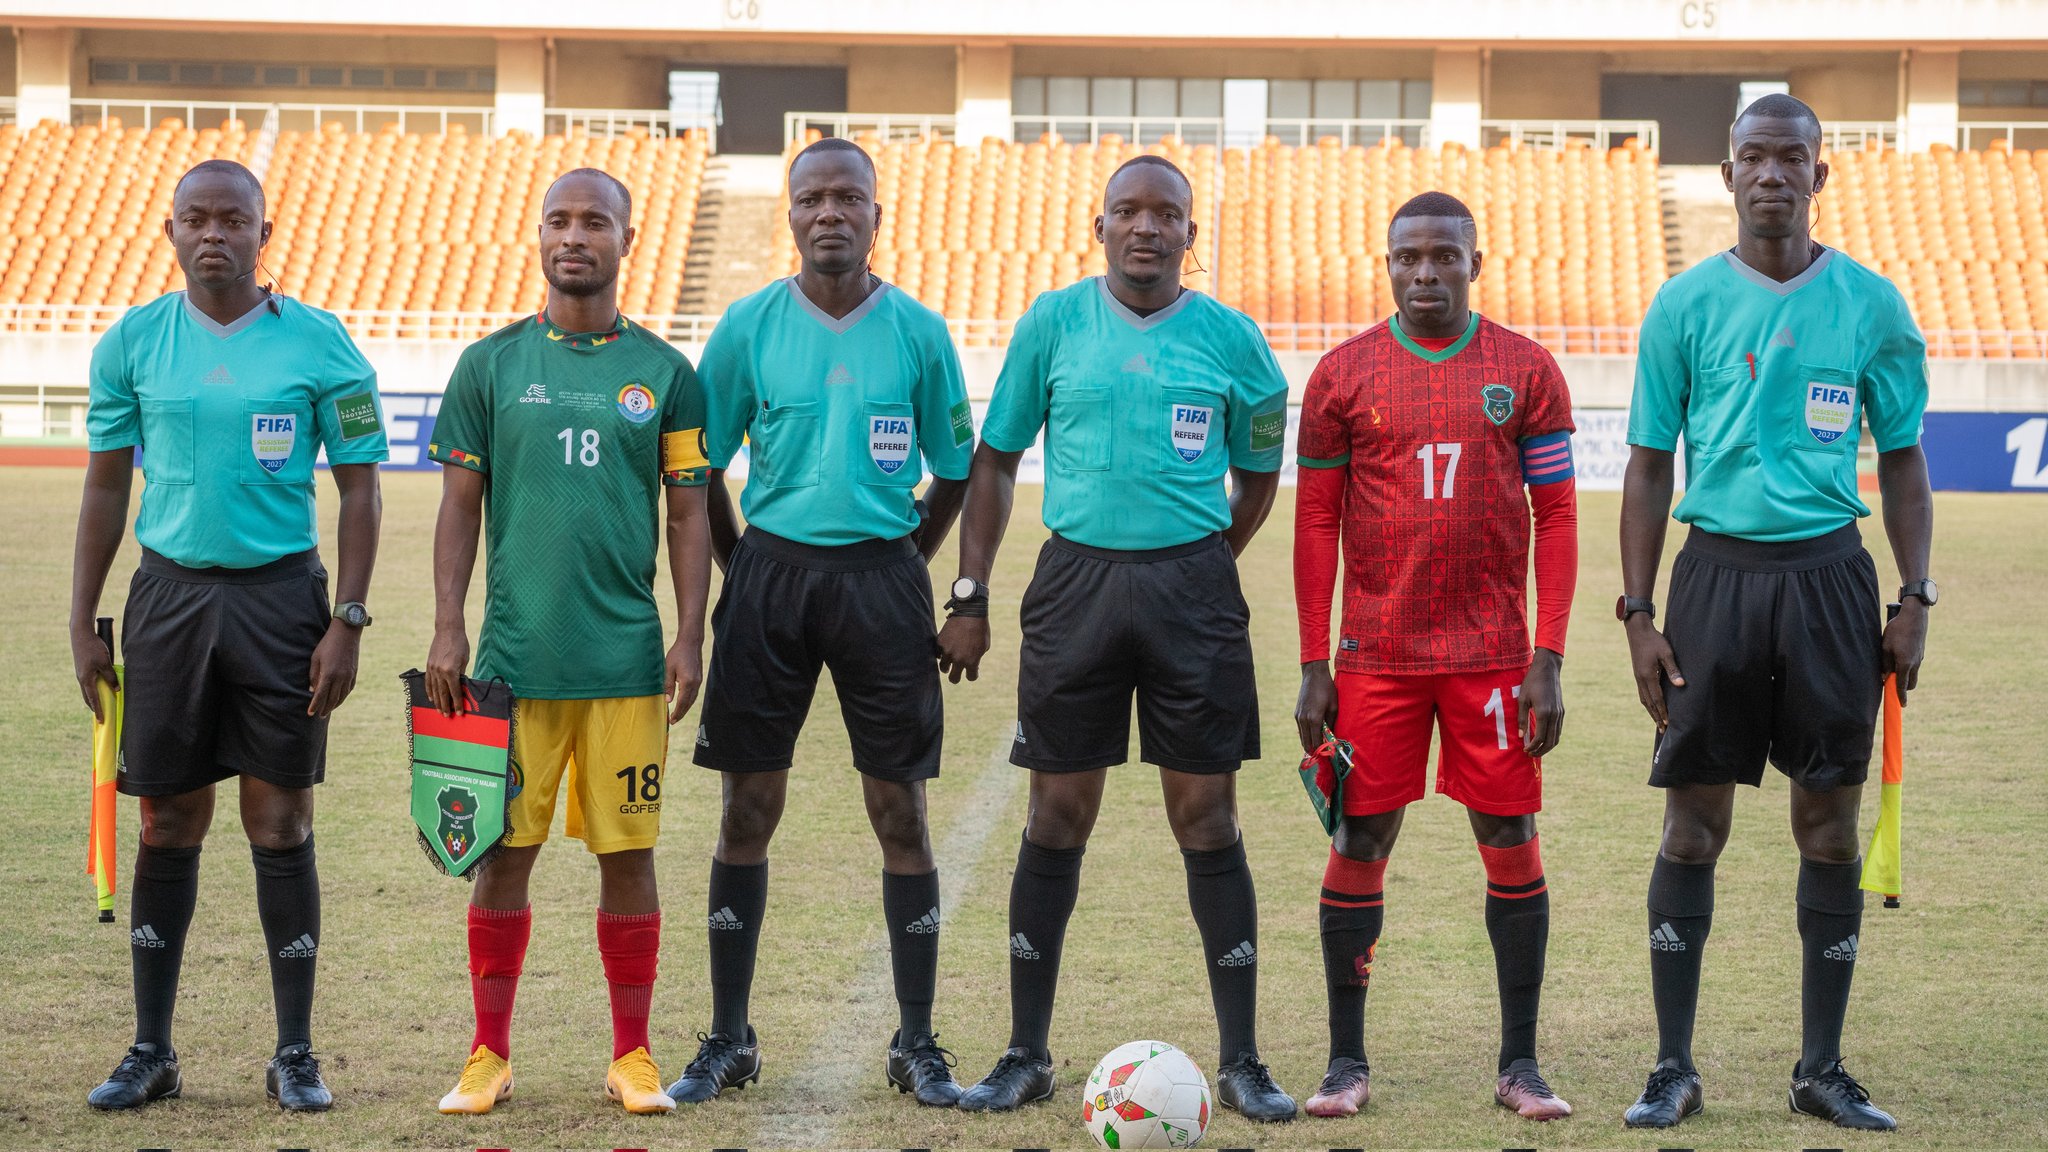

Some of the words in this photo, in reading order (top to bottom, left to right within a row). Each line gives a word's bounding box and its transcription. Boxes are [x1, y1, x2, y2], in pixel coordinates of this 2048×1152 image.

[1682, 2, 1715, 28] C5
[519, 397, 552, 405] GOFERE
[1811, 386, 1850, 405] FIFA
[340, 402, 373, 415] LIVING
[341, 407, 374, 420] FOOTBALL
[1810, 407, 1848, 419] ASSISTANT
[361, 416, 376, 425] FIFA
[1176, 407, 1207, 424] FIFA
[1811, 414, 1845, 425] REFEREE
[257, 418, 293, 432] FIFA
[874, 419, 909, 434] FIFA
[1174, 430, 1205, 441] REFEREE
[1817, 430, 1836, 440] 2023
[258, 445, 289, 453] REFEREE
[557, 428, 600, 467] 18
[873, 442, 908, 451] REFEREE
[1182, 448, 1197, 459] 2023
[266, 460, 283, 468] 2023
[882, 461, 899, 469] 2023
[1416, 443, 1462, 500] 17
[422, 769, 443, 779] FOOTBALL
[444, 773, 472, 784] ASSOCIATION
[479, 780, 498, 788] MALAWI
[616, 763, 661, 803] 18
[619, 803, 662, 814] GOFER
[906, 922, 939, 934] adida
[131, 937, 166, 948] didas
[1650, 939, 1686, 951] didas
[1823, 949, 1857, 962] adida
